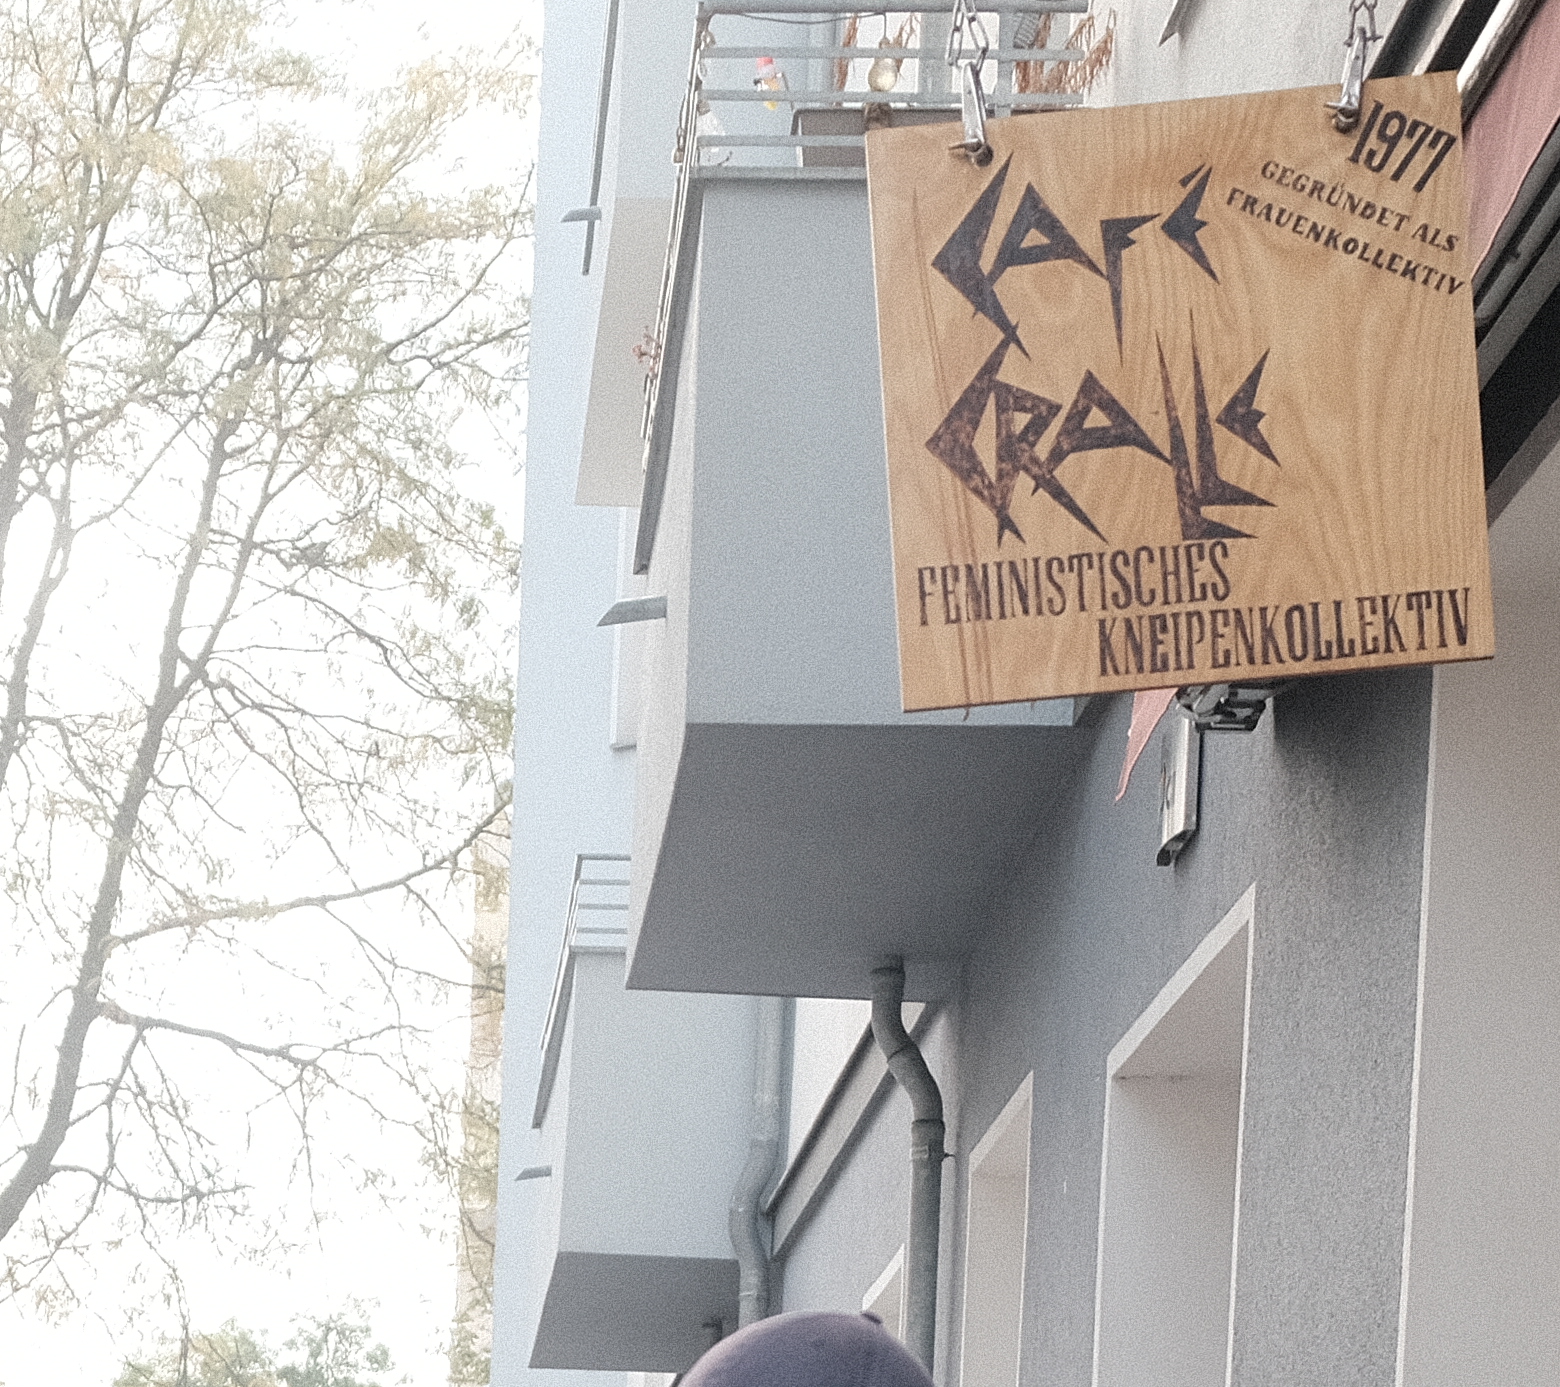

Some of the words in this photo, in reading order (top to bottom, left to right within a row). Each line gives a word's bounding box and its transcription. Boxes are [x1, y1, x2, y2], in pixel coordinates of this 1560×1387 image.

[1346, 98, 1457, 194] 1977
[1226, 185, 1466, 297] FRAUENKOLLEKTIV
[1260, 158, 1411, 236] GEGRÜNDET
[1411, 215, 1460, 254] ALS
[916, 540, 1232, 627] FEMINISTISCHES
[1096, 587, 1473, 677] KNEIPENKOLLEKTIV
